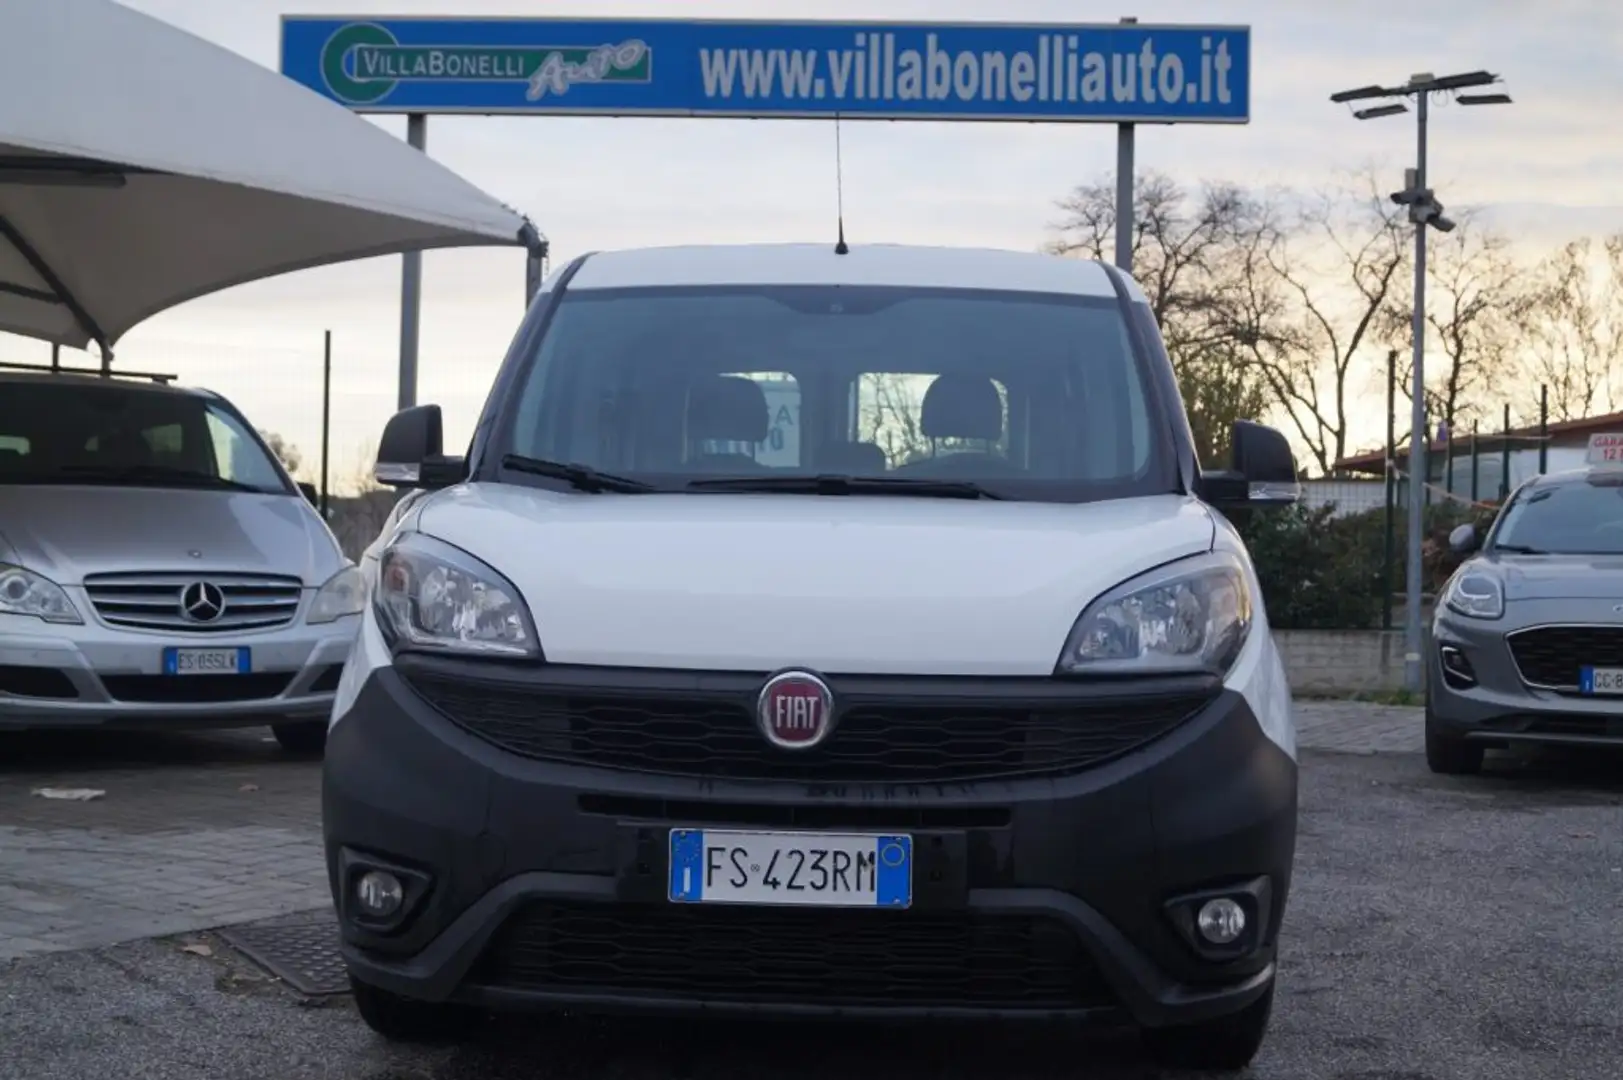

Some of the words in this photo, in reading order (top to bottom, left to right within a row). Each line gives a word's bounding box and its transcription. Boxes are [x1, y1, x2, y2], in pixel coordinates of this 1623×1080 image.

[700, 33, 1231, 103] www.villabonelliauto.it
[776, 696, 819, 729] FIAT
[706, 847, 748, 888] FS
[763, 849, 876, 892] 423RM
